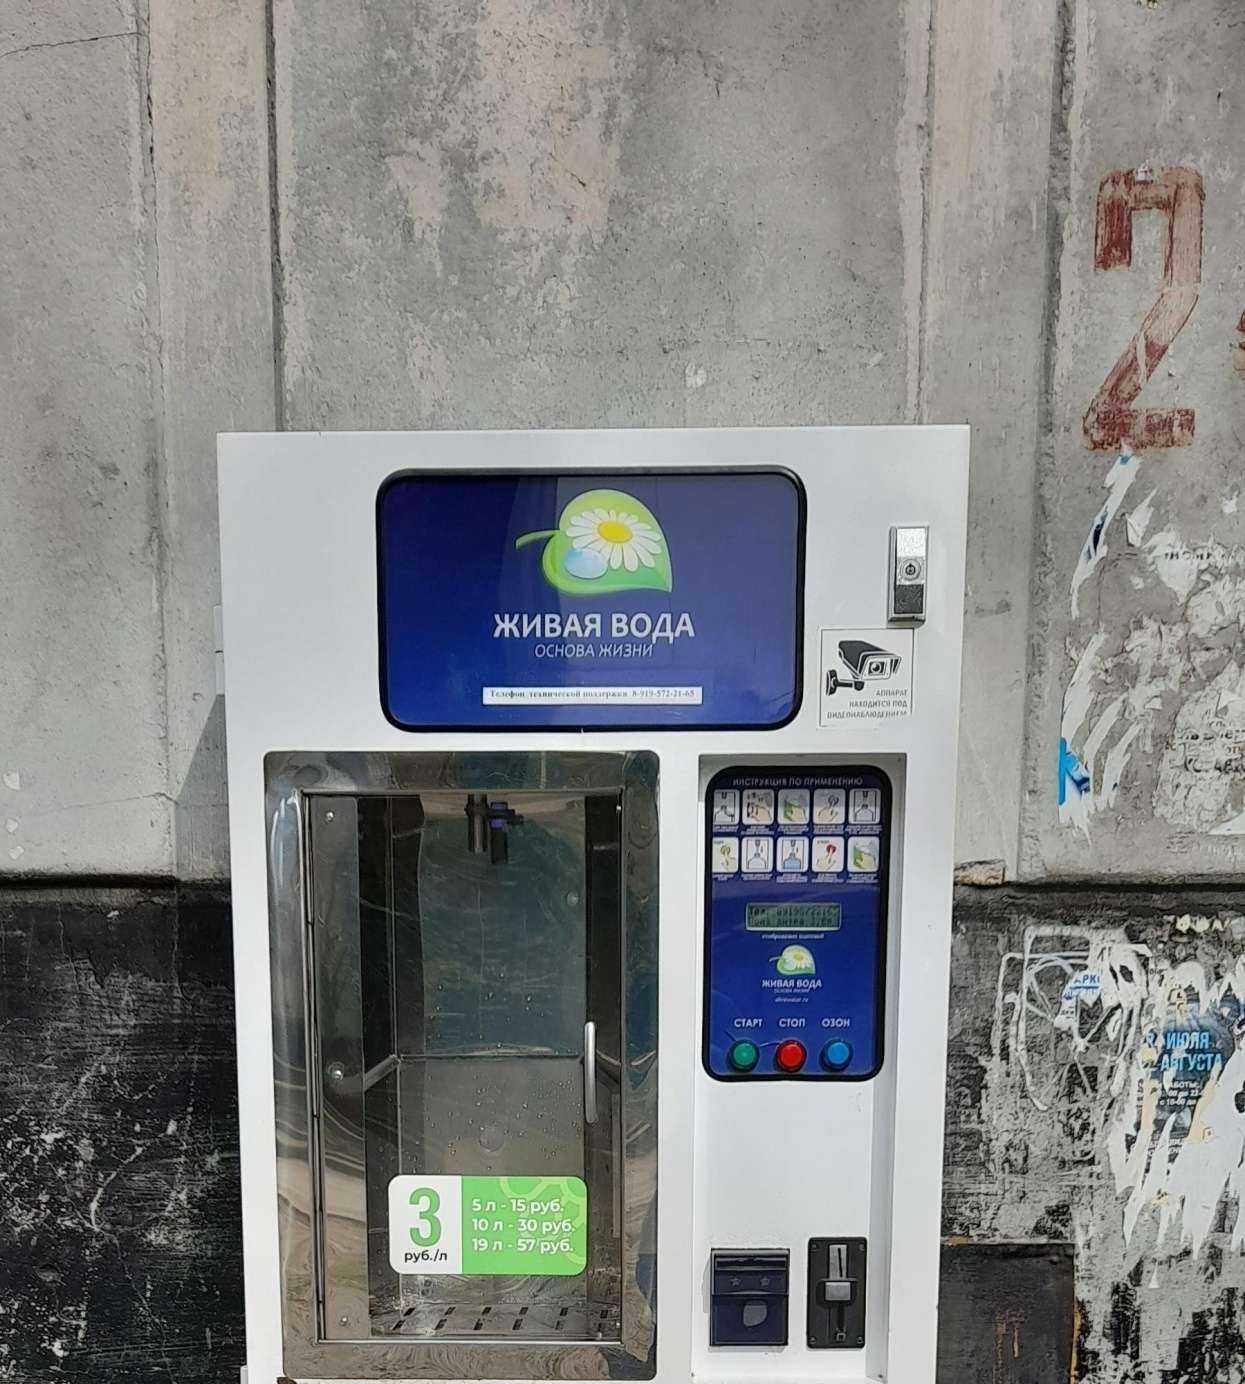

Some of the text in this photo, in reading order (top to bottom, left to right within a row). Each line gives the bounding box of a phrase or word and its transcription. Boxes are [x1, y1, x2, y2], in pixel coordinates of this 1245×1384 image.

[1082, 167, 1203, 454] 2
[493, 613, 695, 644] ЖИВАЯ ВОДА
[534, 644, 653, 658] ОСНОВА ЖИЗНИ
[876, 689, 908, 697] АППАРАТ
[849, 700, 908, 709] НАХОДИТСЯ ПОД
[789, 777, 801, 786] ПО
[762, 979, 822, 990] ЖИВАЯ ВОДА
[734, 1018, 763, 1028] СТАРТ
[779, 1018, 806, 1028] СТОП
[821, 1018, 850, 1028] ОЗОН
[1166, 1031, 1210, 1050] ИЮЛЯ
[1160, 1053, 1223, 1072] АВГУСТА
[472, 1199, 481, 1212] 5
[485, 1202, 496, 1212] л
[510, 1199, 525, 1212] 15
[531, 1199, 564, 1215] руб.
[409, 1187, 442, 1247] 3
[472, 1219, 489, 1232] 10
[492, 1222, 503, 1232] л
[518, 1219, 537, 1232] 30
[542, 1219, 575, 1235] руб.
[472, 1238, 488, 1252] 19
[492, 1242, 503, 1252] л
[517, 1238, 536, 1252] 57
[540, 1238, 574, 1254] руб.
[404, 1250, 448, 1263] руб./л
